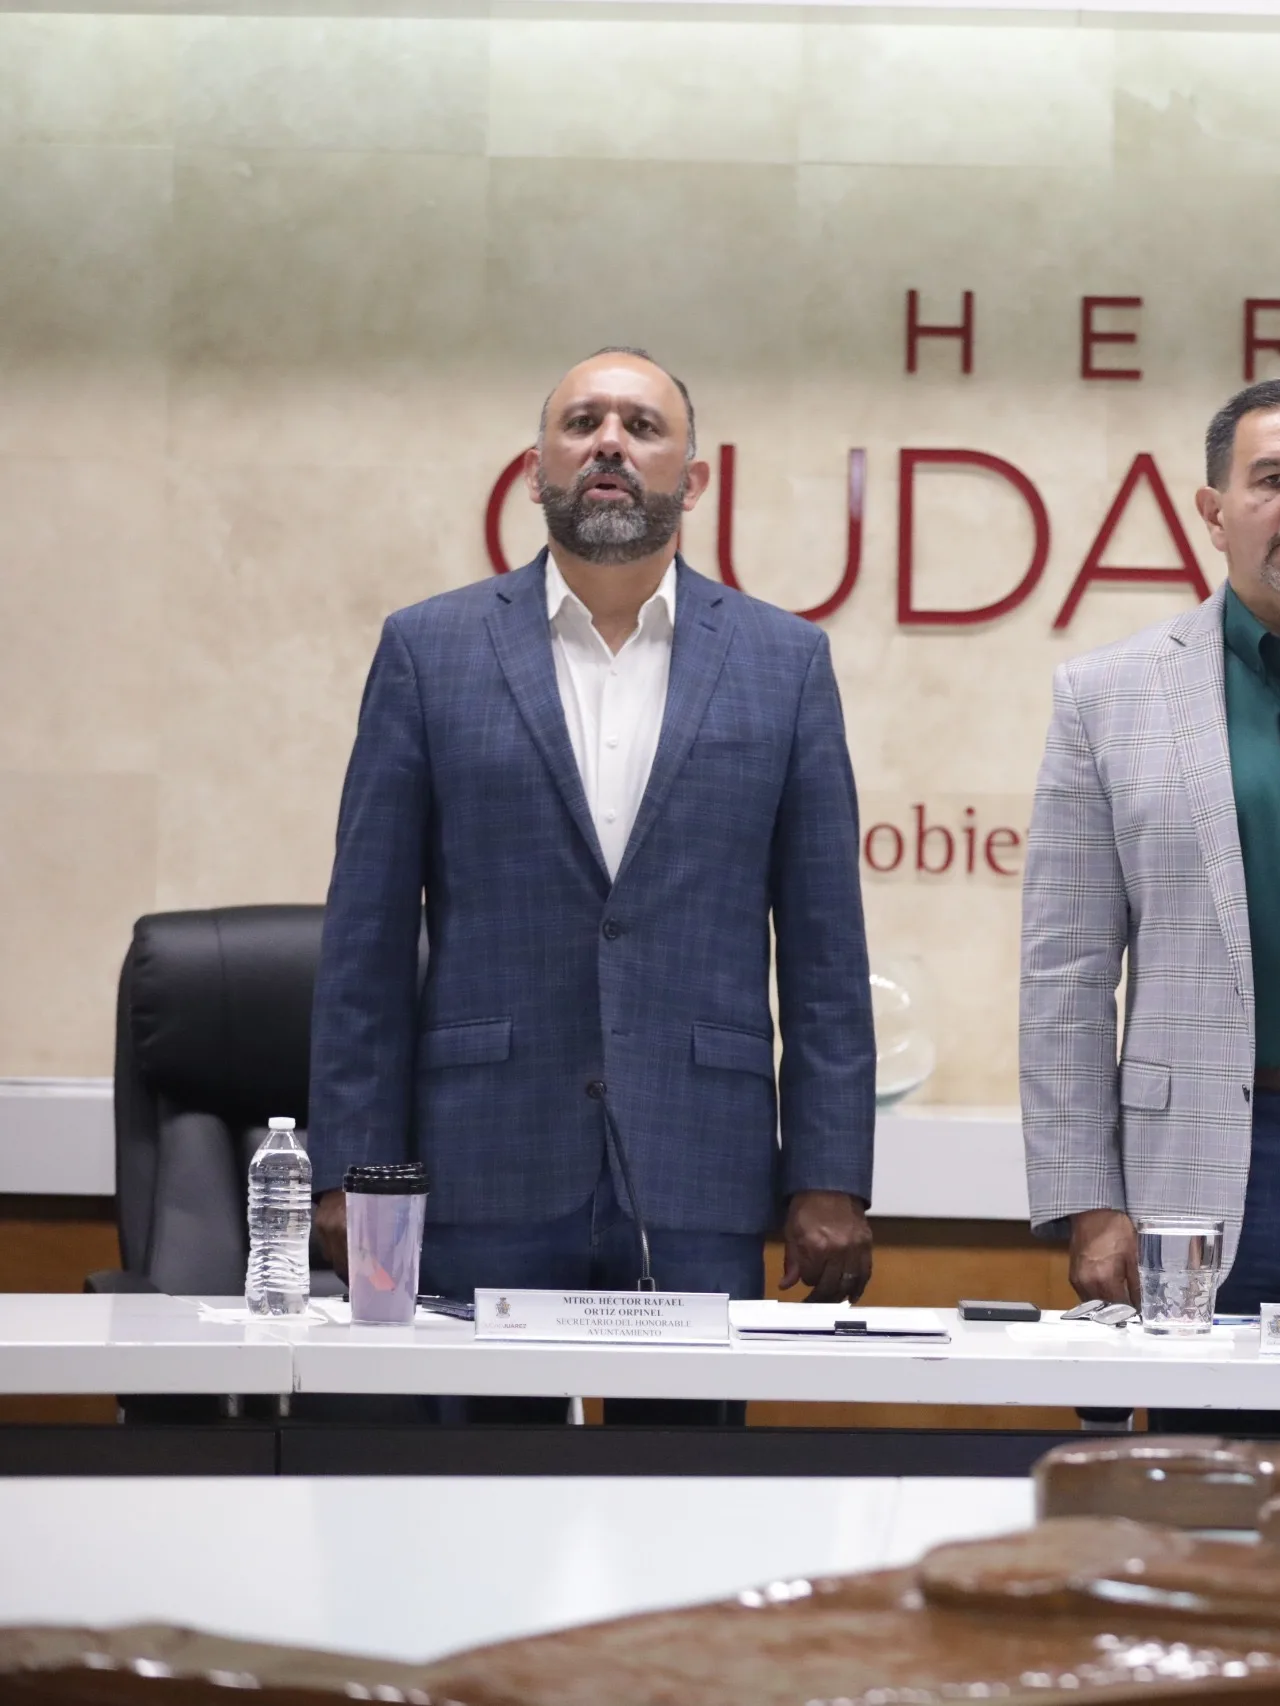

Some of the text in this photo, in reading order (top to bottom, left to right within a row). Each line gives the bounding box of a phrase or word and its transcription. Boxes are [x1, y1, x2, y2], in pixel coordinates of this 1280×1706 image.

[563, 1296, 684, 1307] MTRO. HÉCTOR RAFAEL
[618, 1308, 664, 1317] ORPINEL
[556, 1317, 692, 1328] SECRETARIO DEL HONORABLE
[587, 1328, 662, 1337] AYUNTAMIENTO
